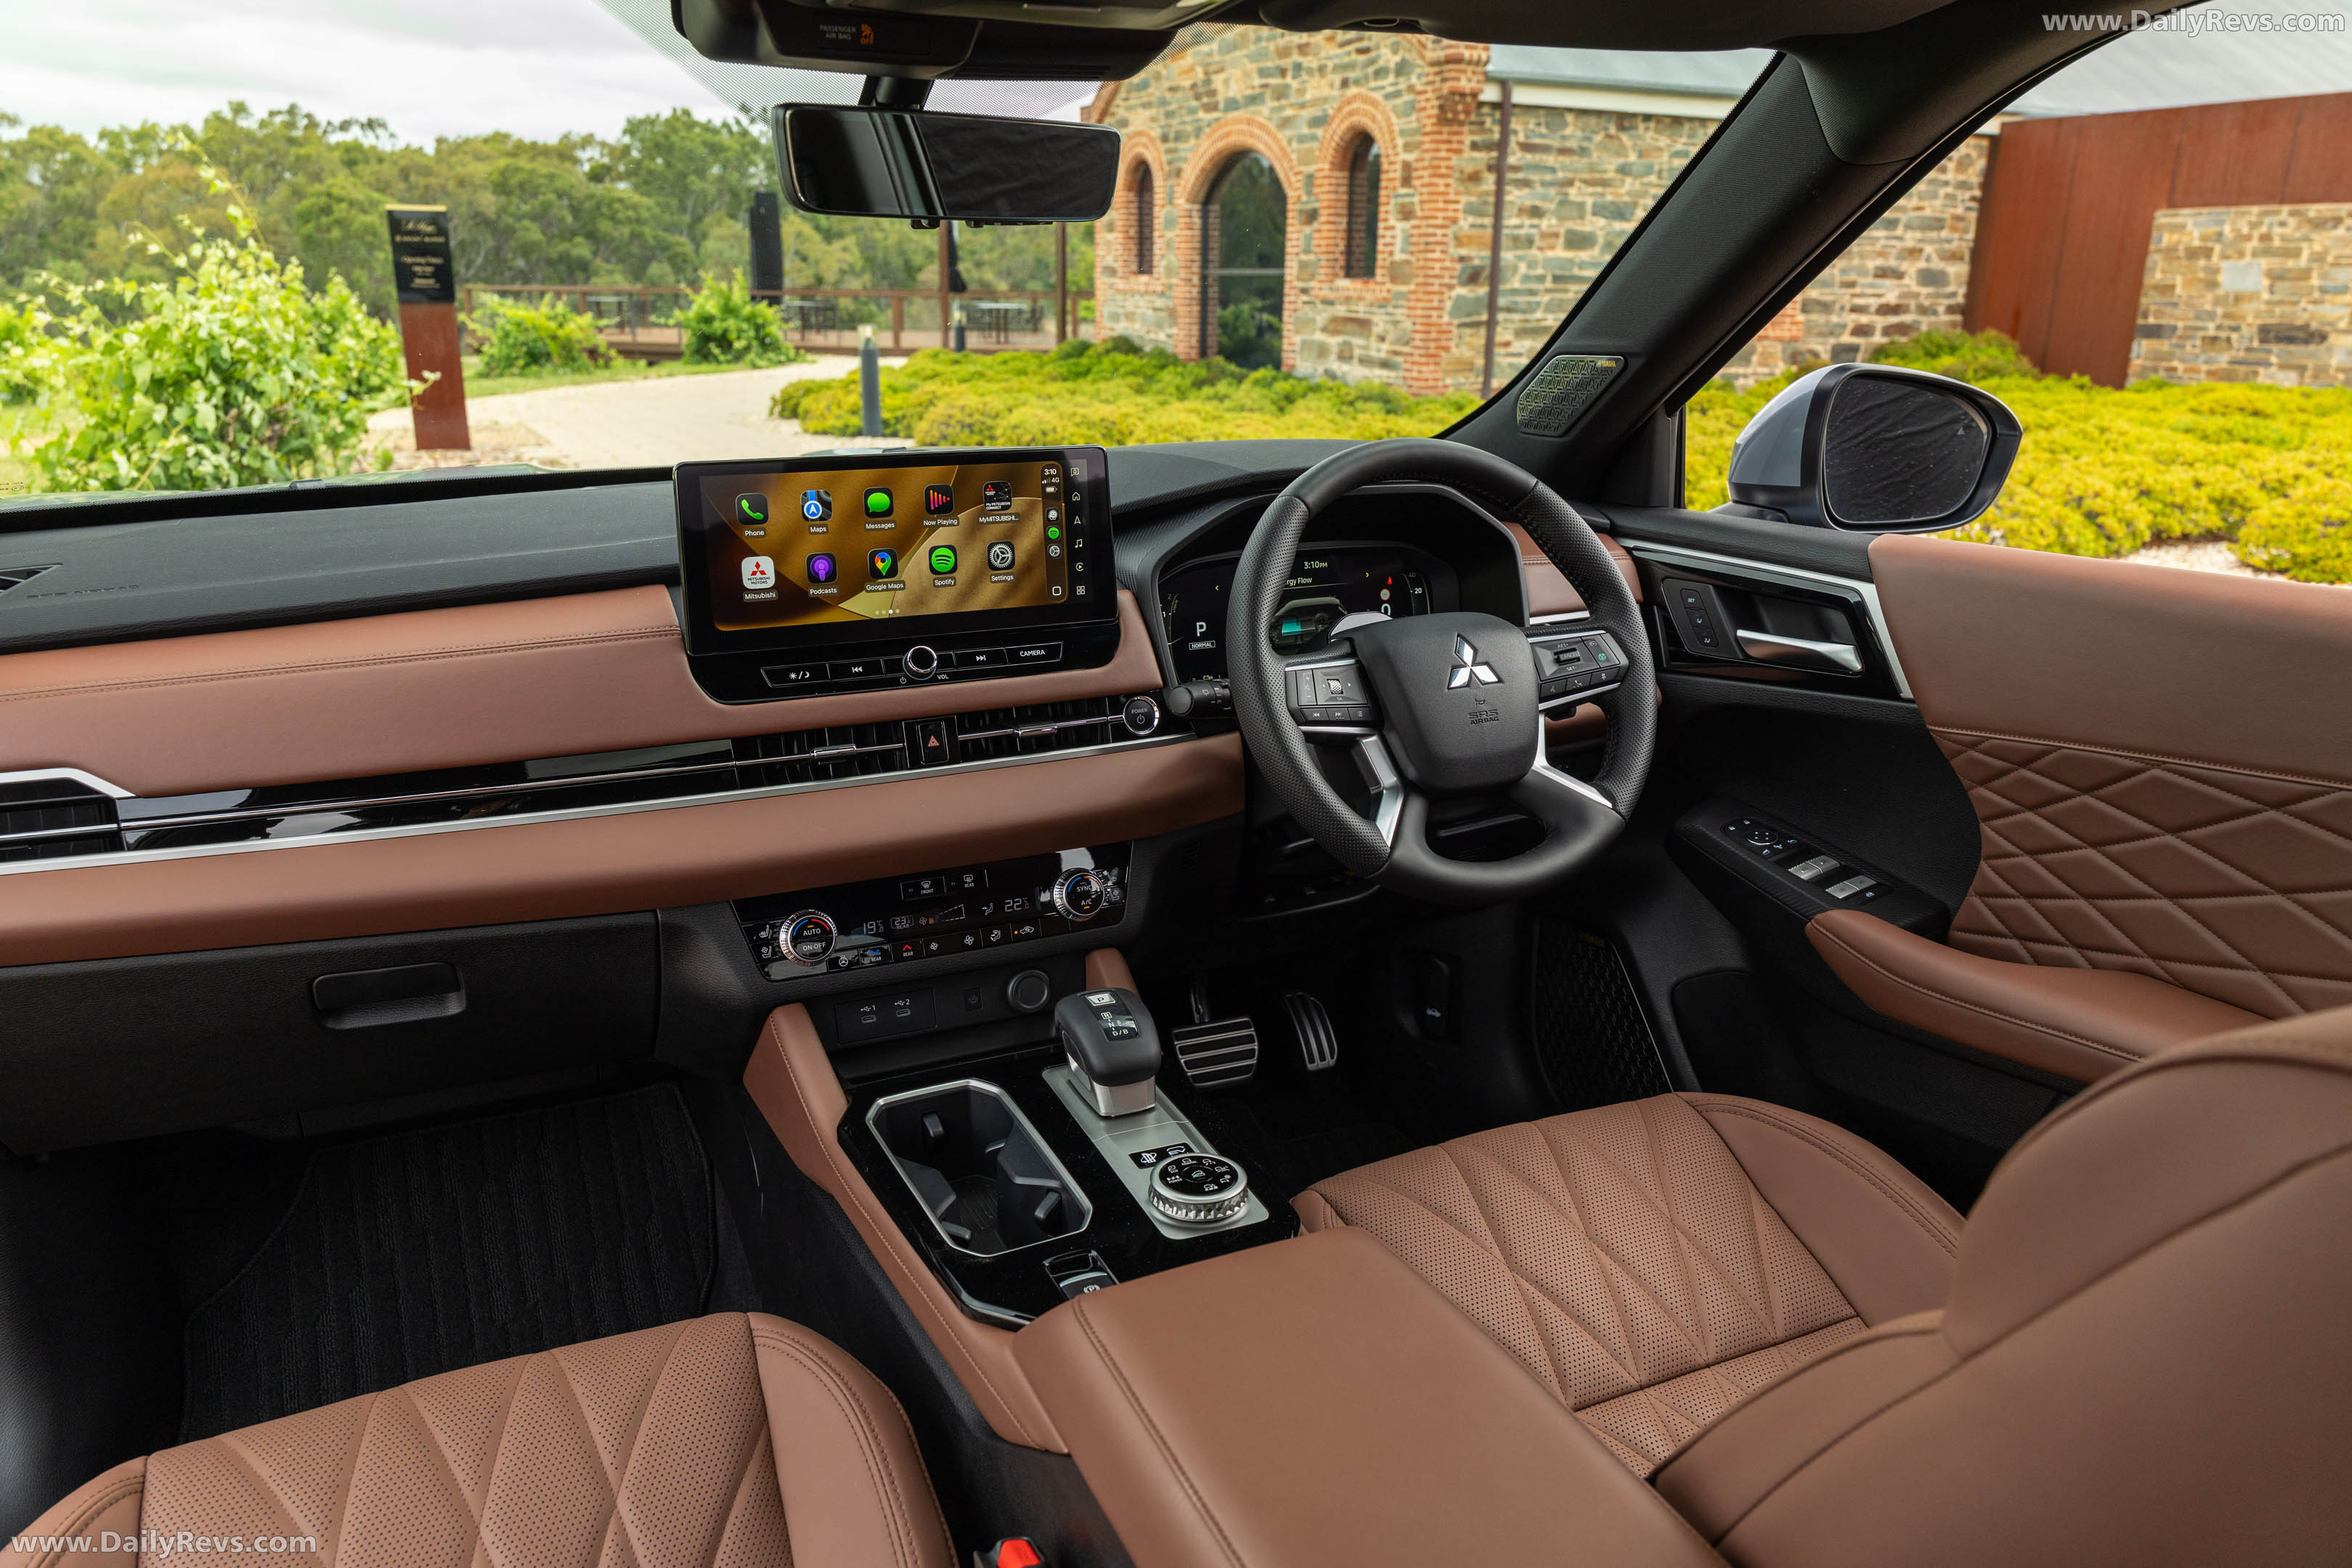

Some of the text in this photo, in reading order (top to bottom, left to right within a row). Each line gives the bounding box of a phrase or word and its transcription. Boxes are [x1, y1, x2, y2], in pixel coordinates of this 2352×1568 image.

[1196, 621, 1207, 637] P
[1560, 650, 1580, 659] CANCEL
[1468, 709, 1499, 719] SRS
[1470, 716, 1499, 725] AIRBAG
[1076, 884, 1092, 893] SYNC
